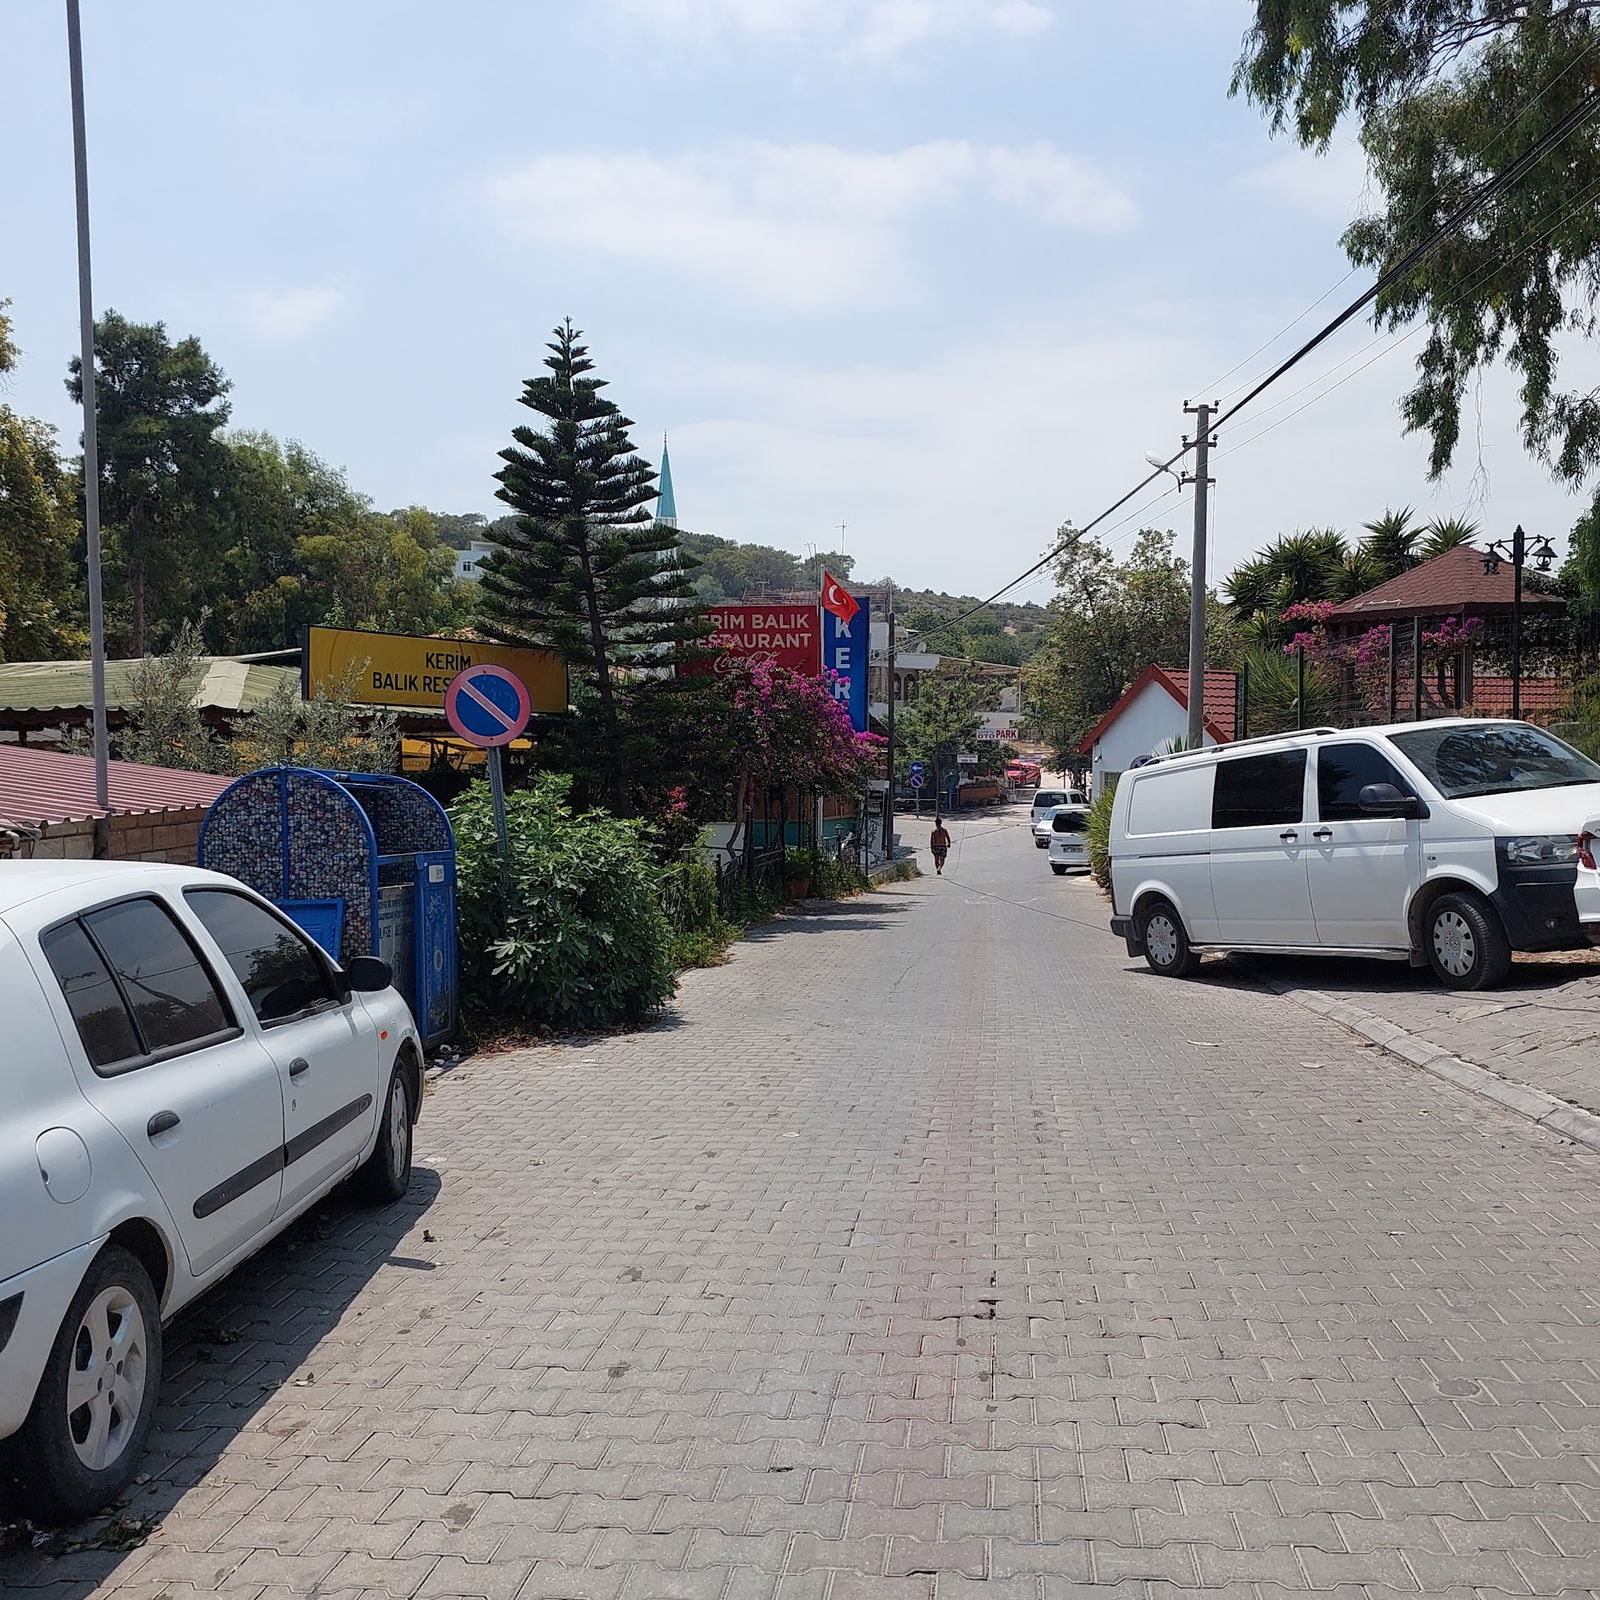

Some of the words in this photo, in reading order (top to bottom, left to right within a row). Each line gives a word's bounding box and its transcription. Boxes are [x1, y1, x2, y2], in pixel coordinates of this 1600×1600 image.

[751, 614, 810, 629] BALIK
[425, 651, 472, 671] KERİM
[372, 671, 419, 692] BALIK
[422, 675, 454, 694] RES
[996, 729, 1017, 739] PARK
